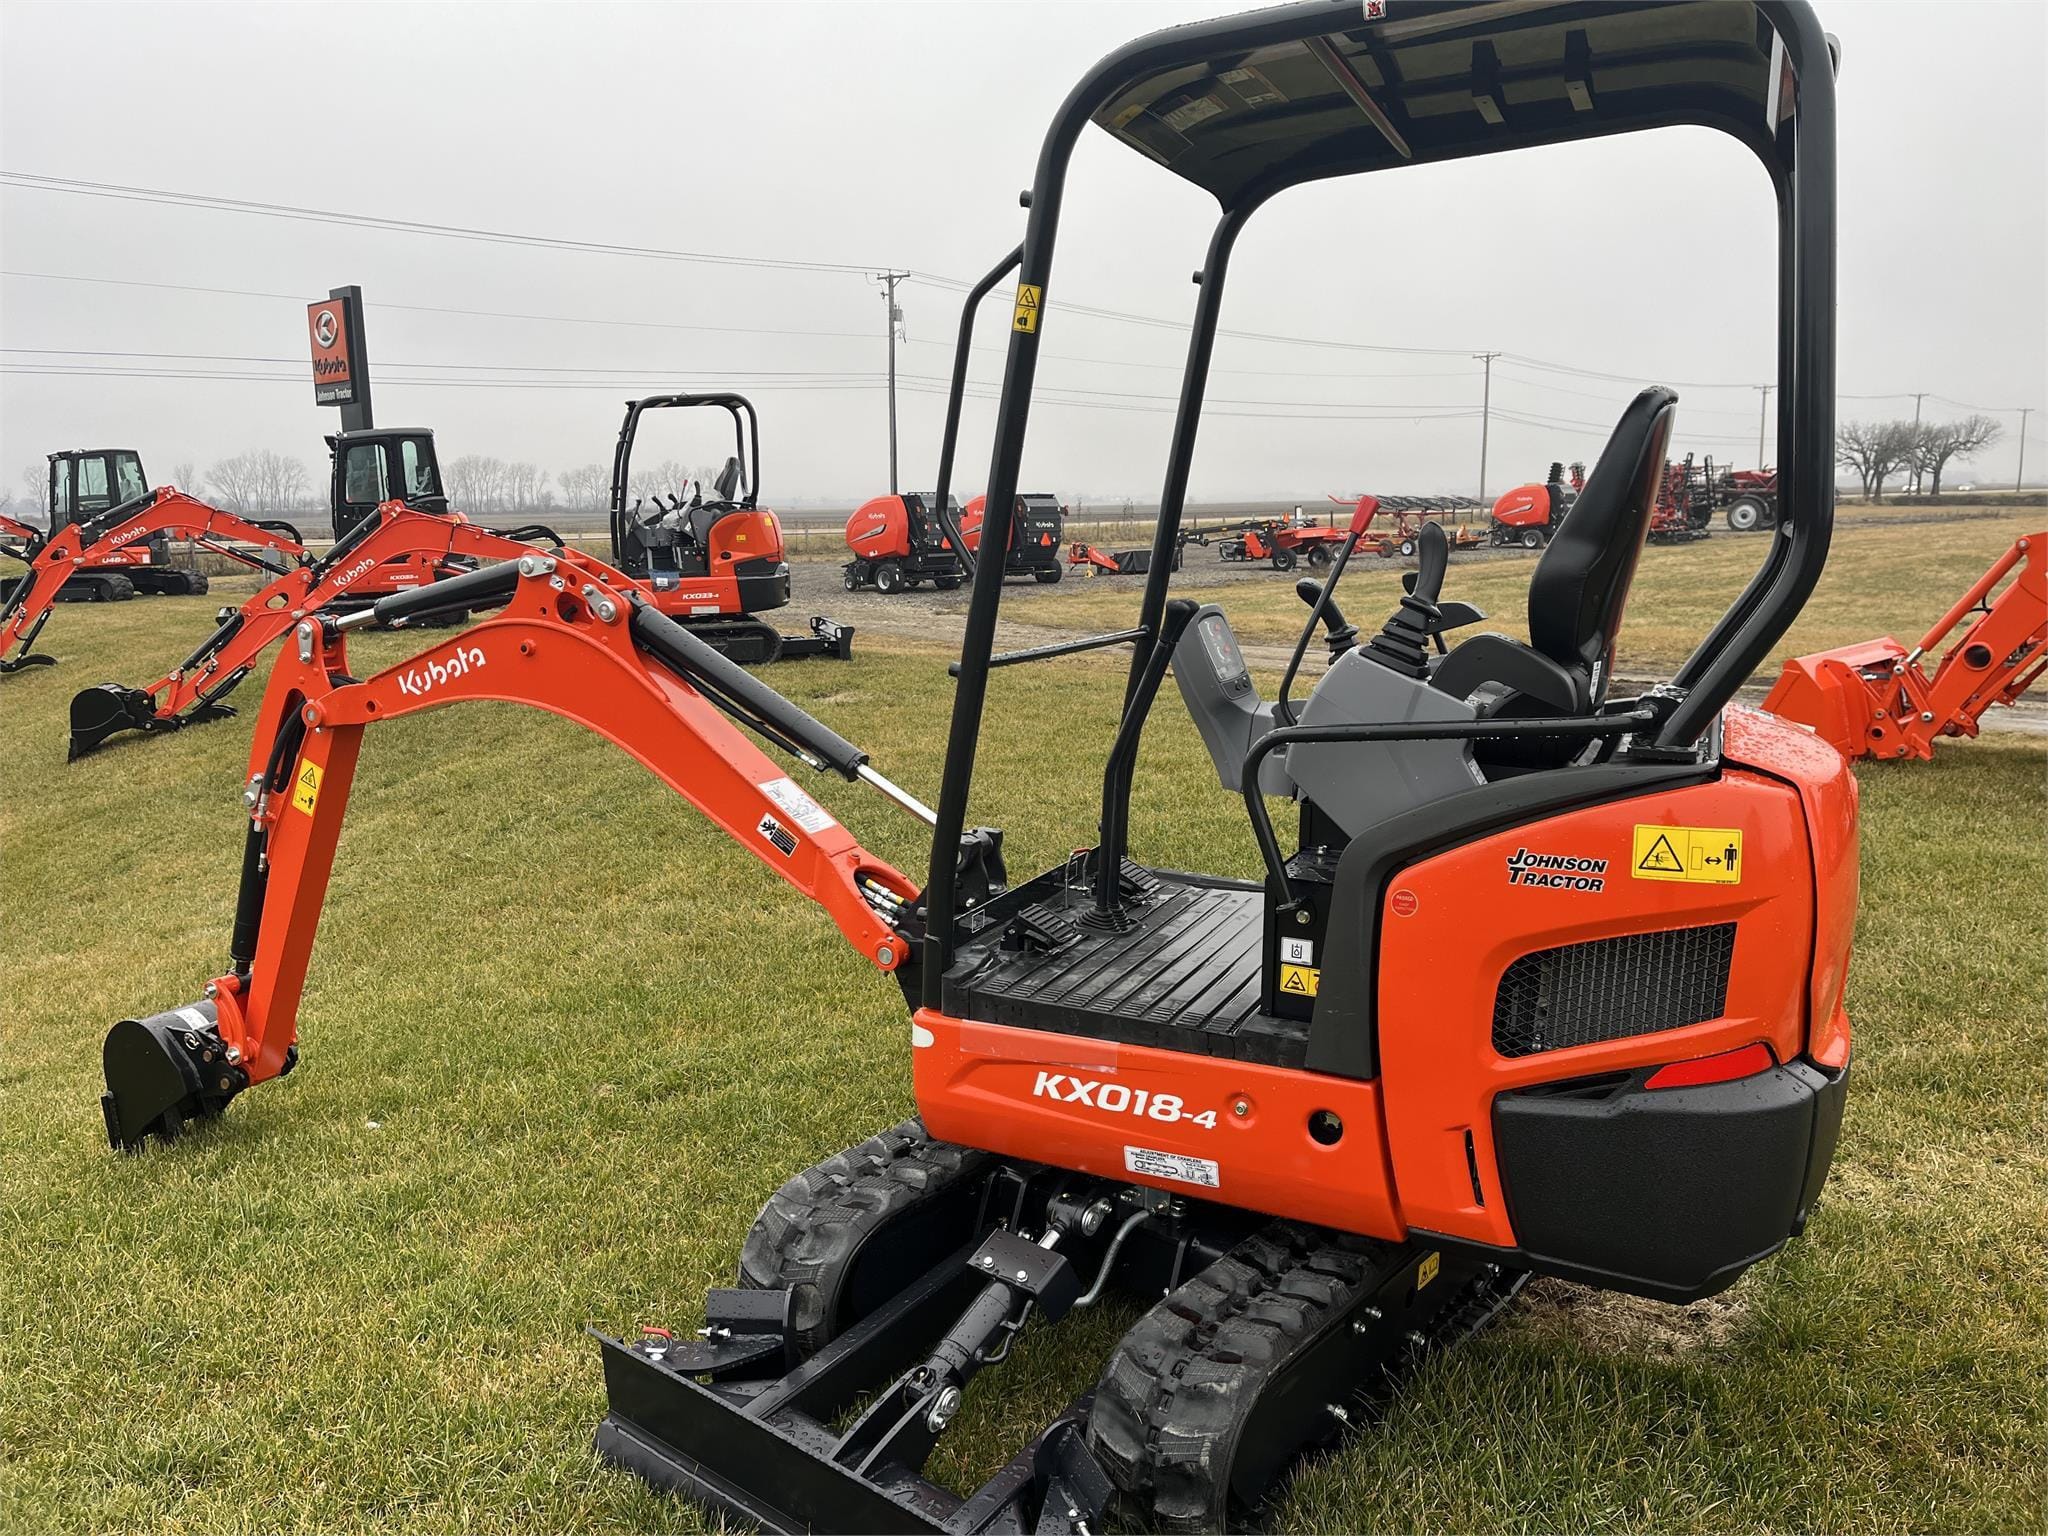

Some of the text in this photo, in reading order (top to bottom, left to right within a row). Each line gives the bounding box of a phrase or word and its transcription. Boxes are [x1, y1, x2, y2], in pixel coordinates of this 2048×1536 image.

[315, 356, 347, 374] Kubota
[317, 387, 352, 401] Johnson Tractor
[868, 512, 886, 520] Kubota
[1035, 520, 1055, 528] Kubota
[110, 526, 147, 544] Kubota
[332, 558, 376, 587] Kubota
[682, 592, 719, 600] KX033-4
[397, 646, 487, 696] Kubota
[1033, 1071, 1217, 1129] KX018-4
